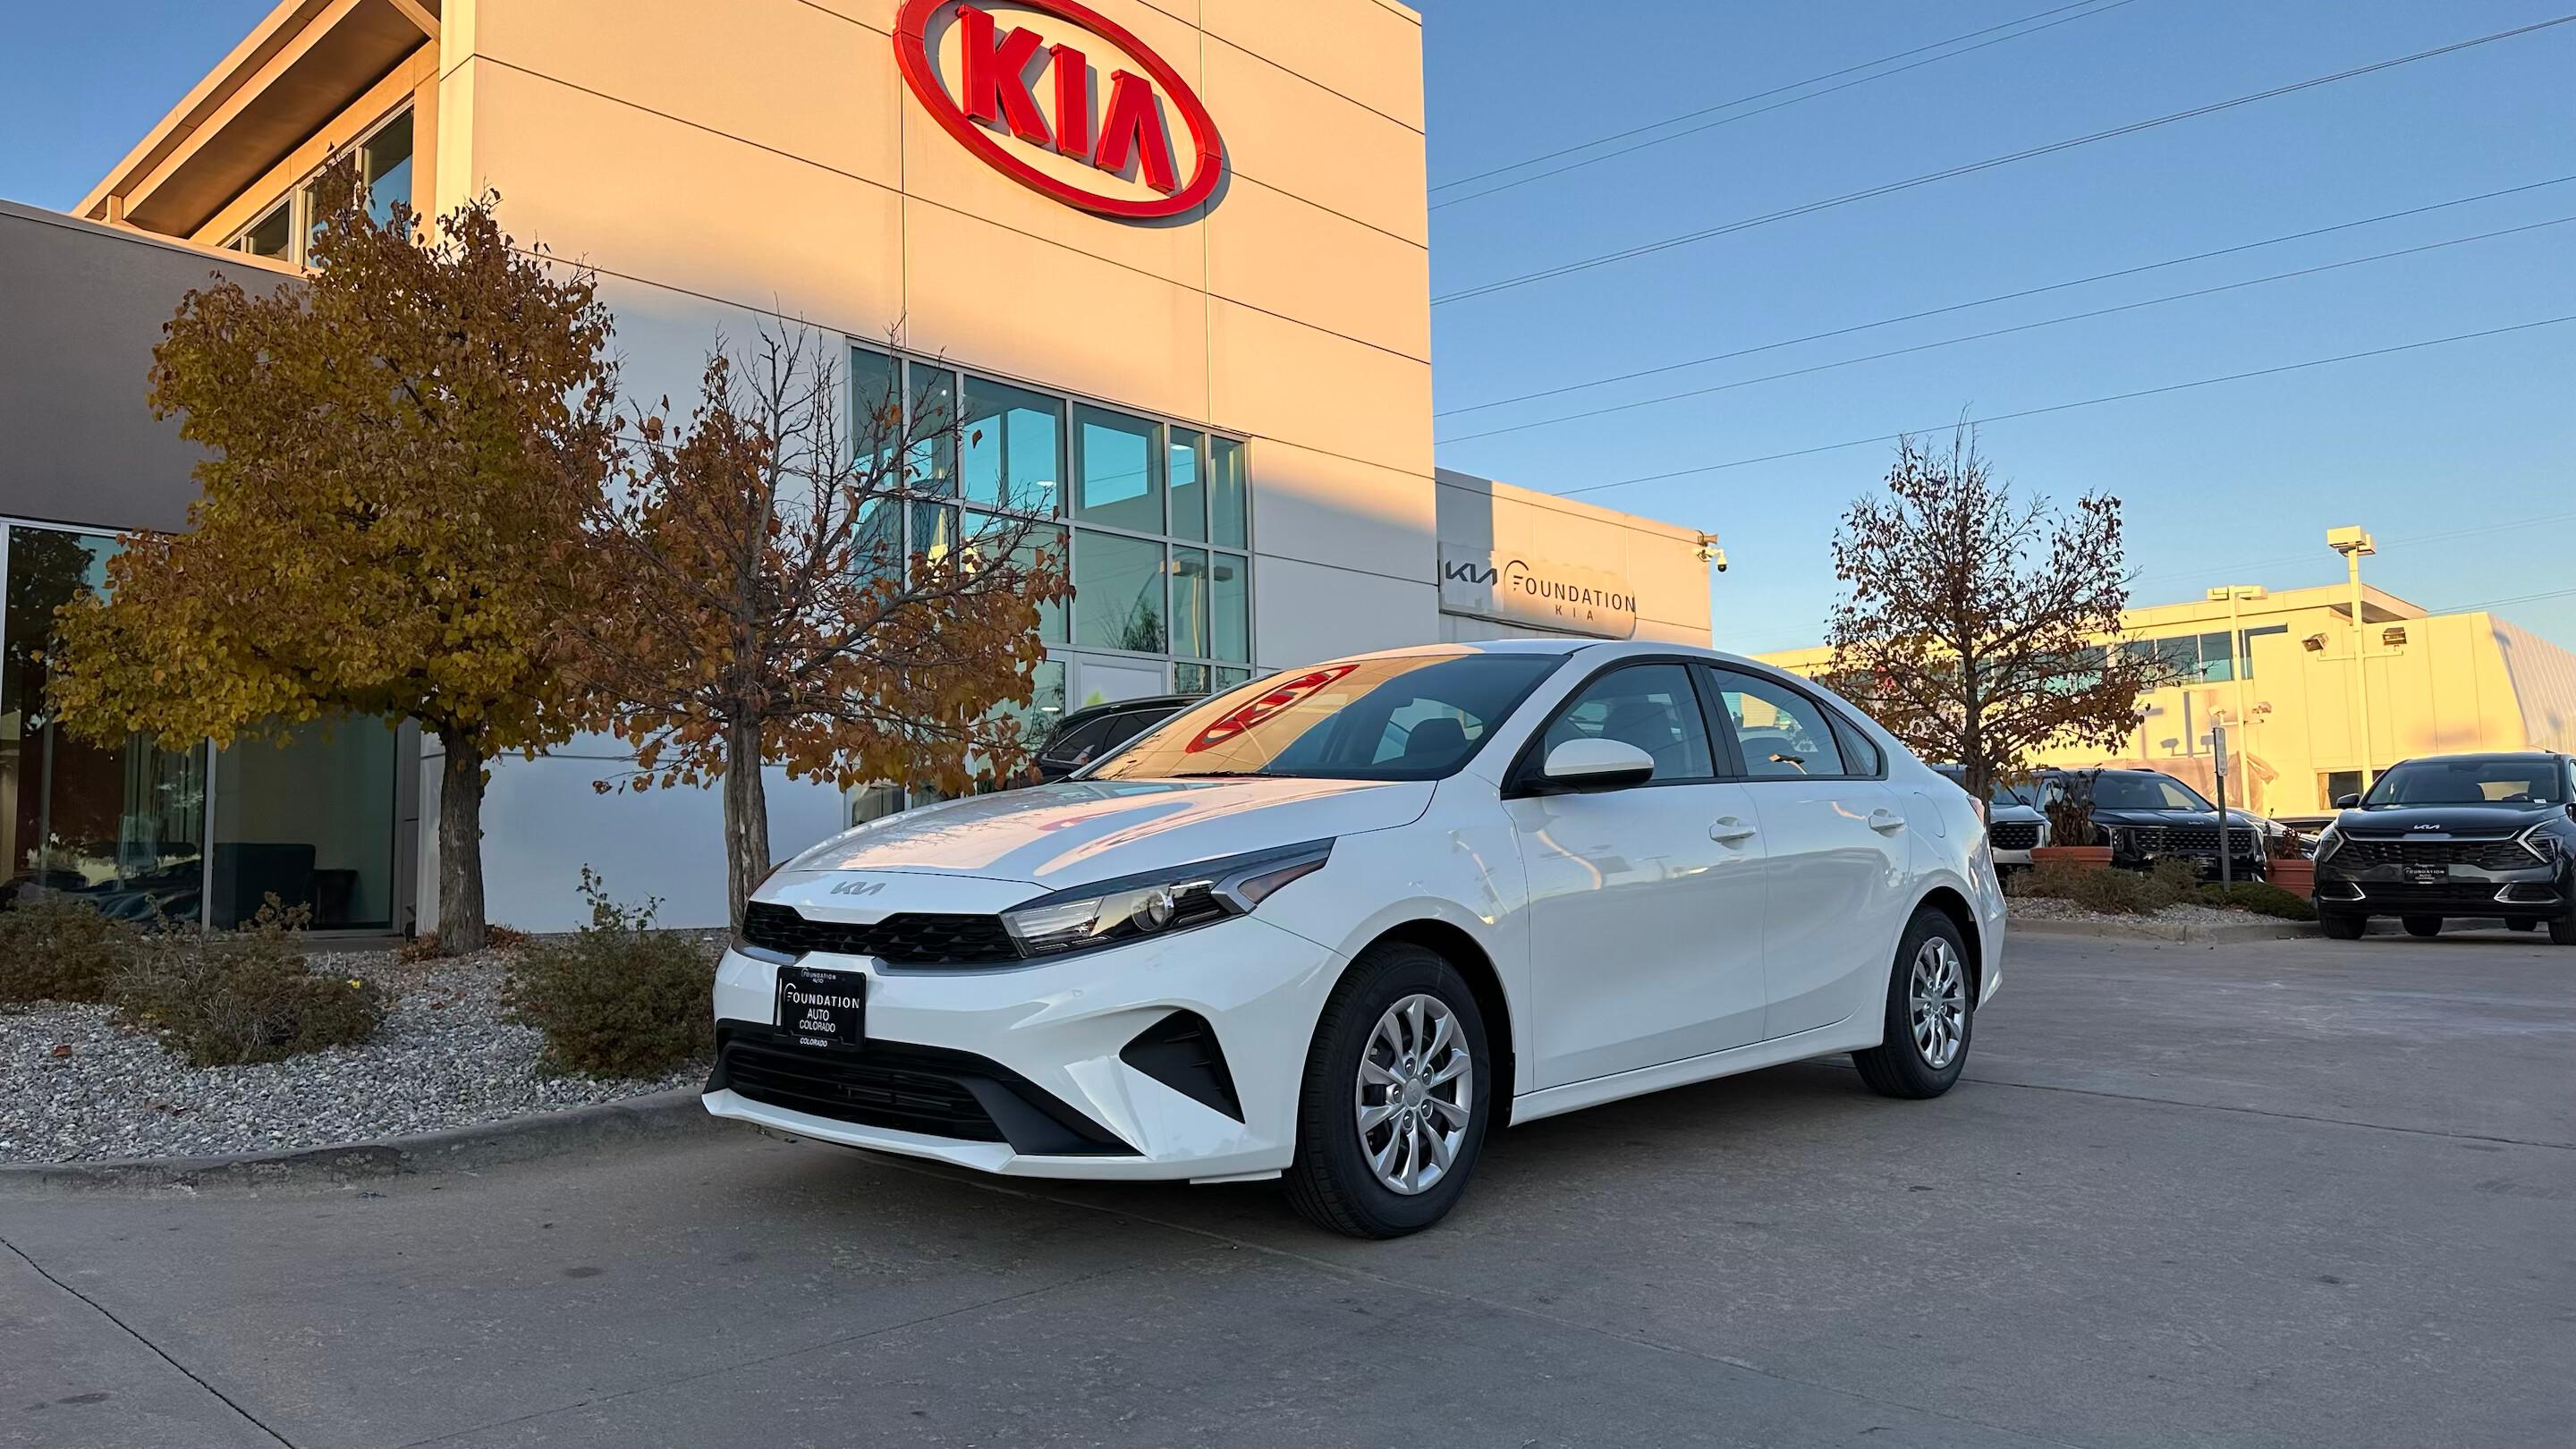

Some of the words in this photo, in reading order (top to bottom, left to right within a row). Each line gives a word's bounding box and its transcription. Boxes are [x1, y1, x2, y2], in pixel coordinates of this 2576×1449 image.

[955, 4, 1176, 196] KIA
[1445, 560, 1498, 586] KIA
[1504, 560, 1635, 613] FOUNDATION
[1555, 605, 1594, 622] KIA
[830, 881, 886, 895] KIA
[801, 968, 836, 979] FOUNDATION
[784, 983, 860, 1008] FOUNDATION
[807, 1008, 829, 1021] AUTO
[800, 1020, 835, 1033] COLORADO
[800, 1038, 827, 1047] COLORADO
